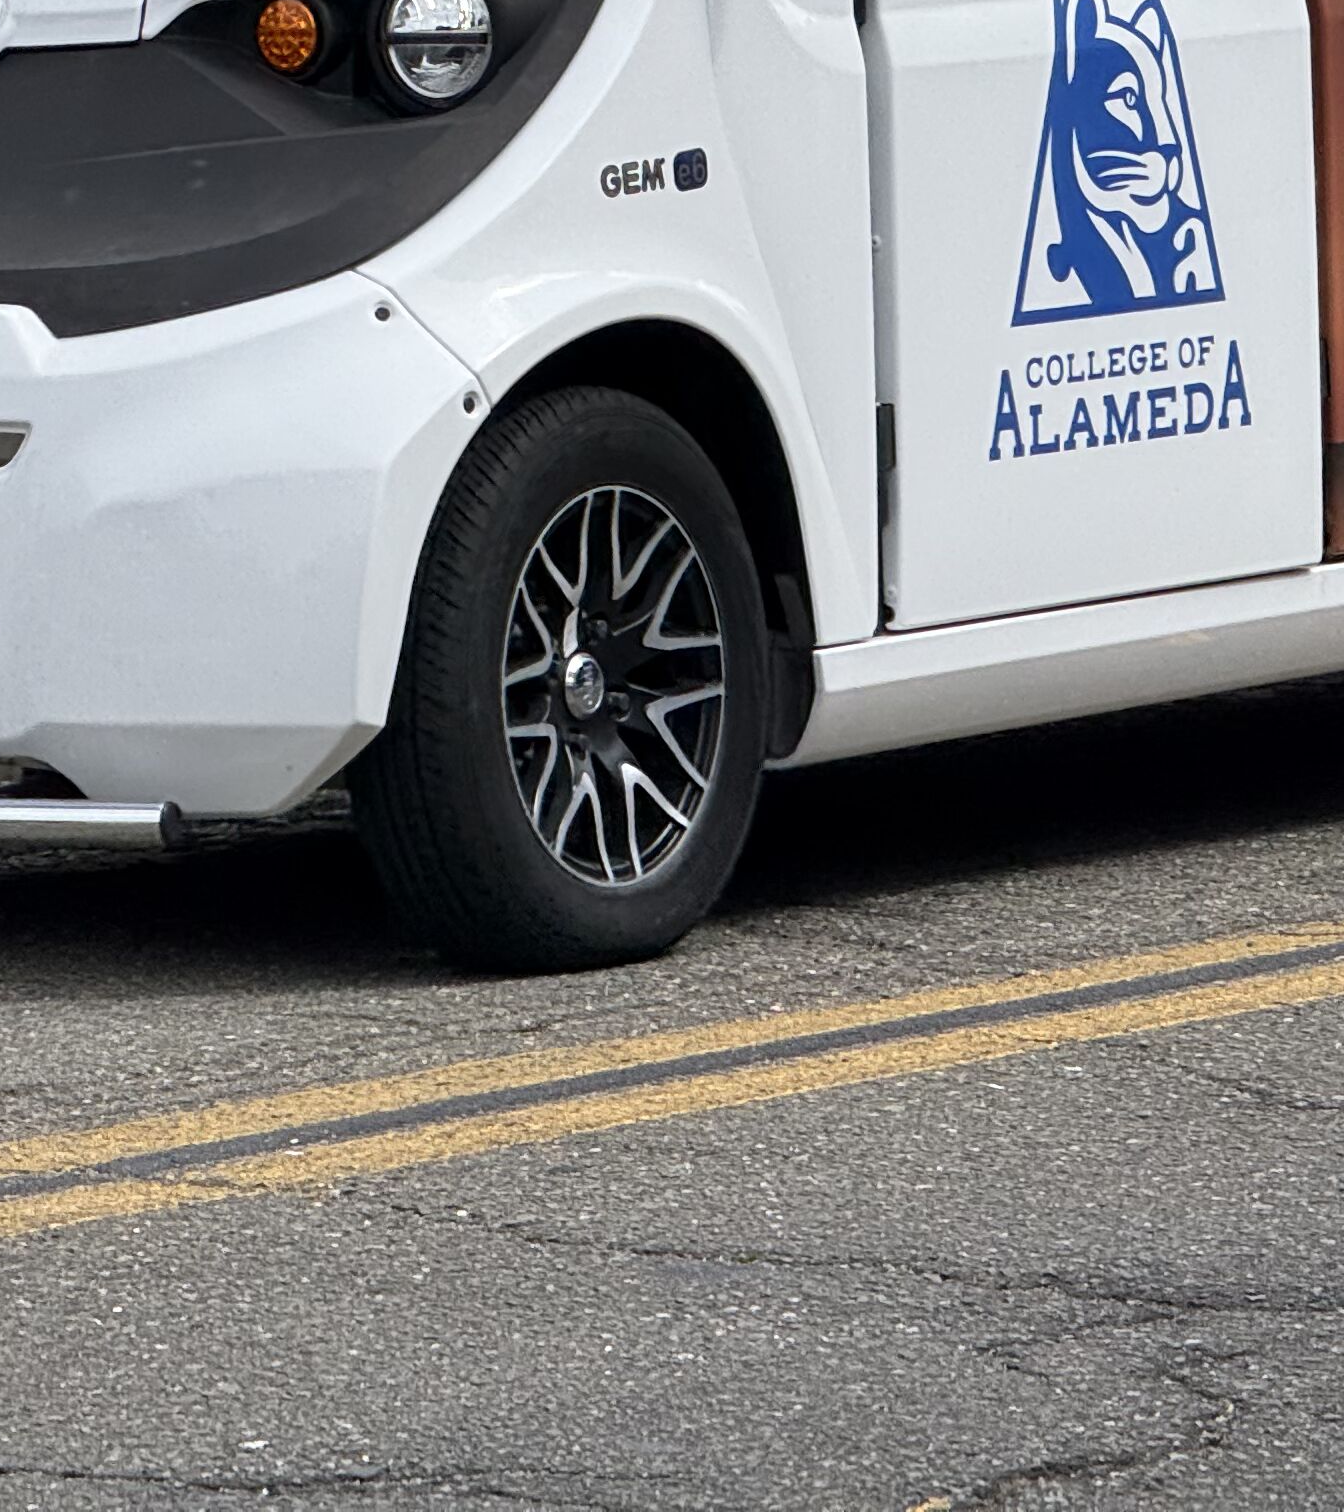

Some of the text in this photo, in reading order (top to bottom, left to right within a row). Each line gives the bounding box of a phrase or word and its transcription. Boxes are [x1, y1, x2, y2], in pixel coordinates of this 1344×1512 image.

[600, 152, 707, 199] GEM e6
[1025, 335, 1215, 389] COLLEGE OF
[988, 339, 1252, 462] ALAMEDA
